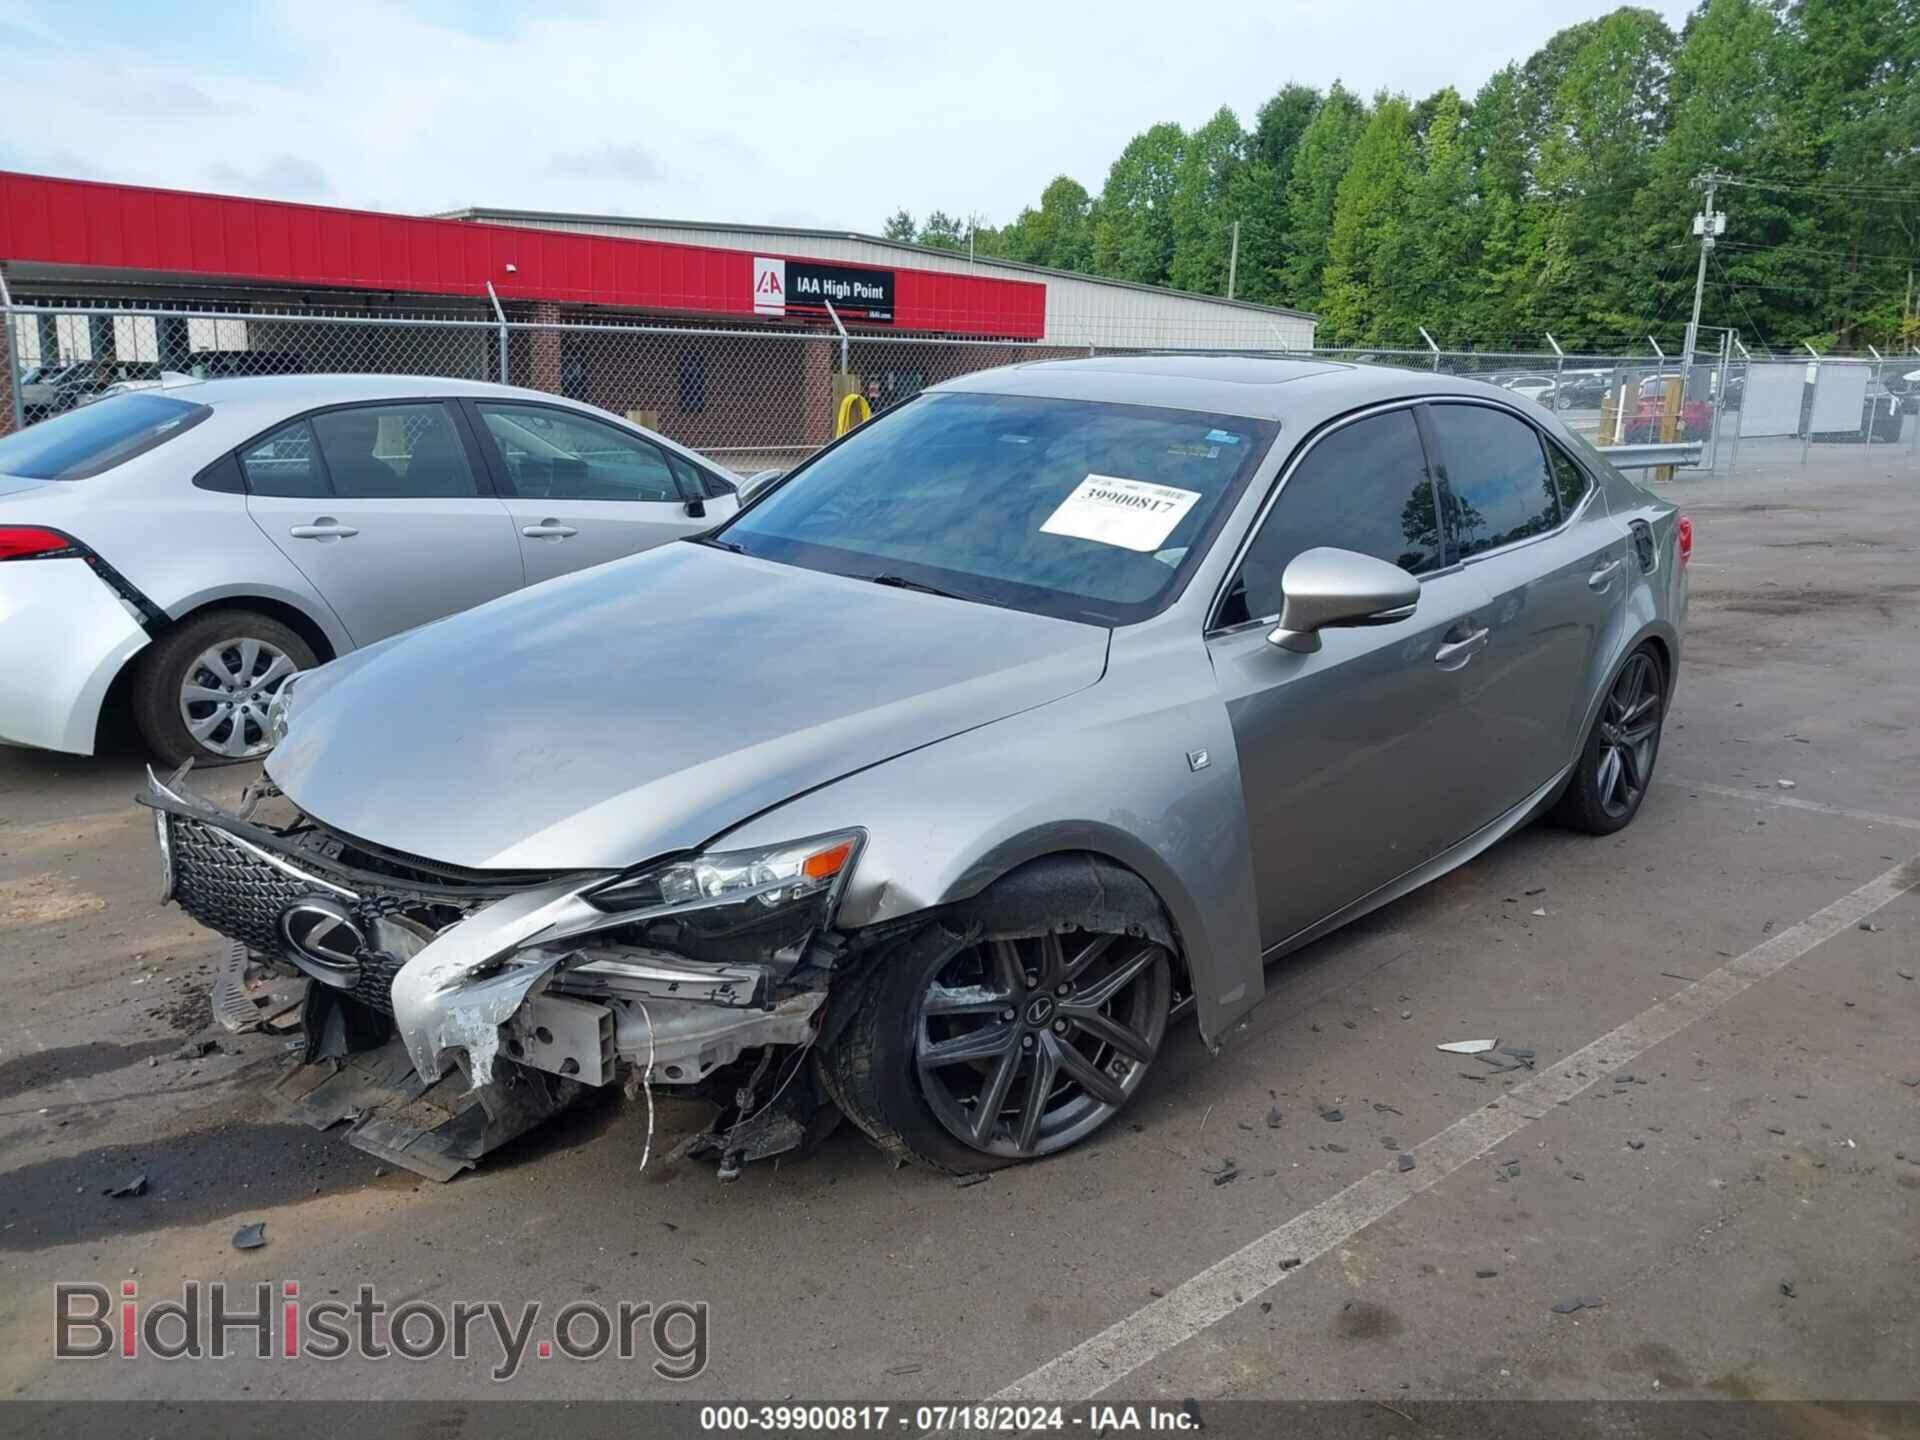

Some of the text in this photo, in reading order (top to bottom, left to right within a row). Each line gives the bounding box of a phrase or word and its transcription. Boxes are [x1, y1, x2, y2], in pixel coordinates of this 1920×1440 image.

[797, 276, 884, 300] IAA High Point
[1081, 487, 1176, 513] 39900817
